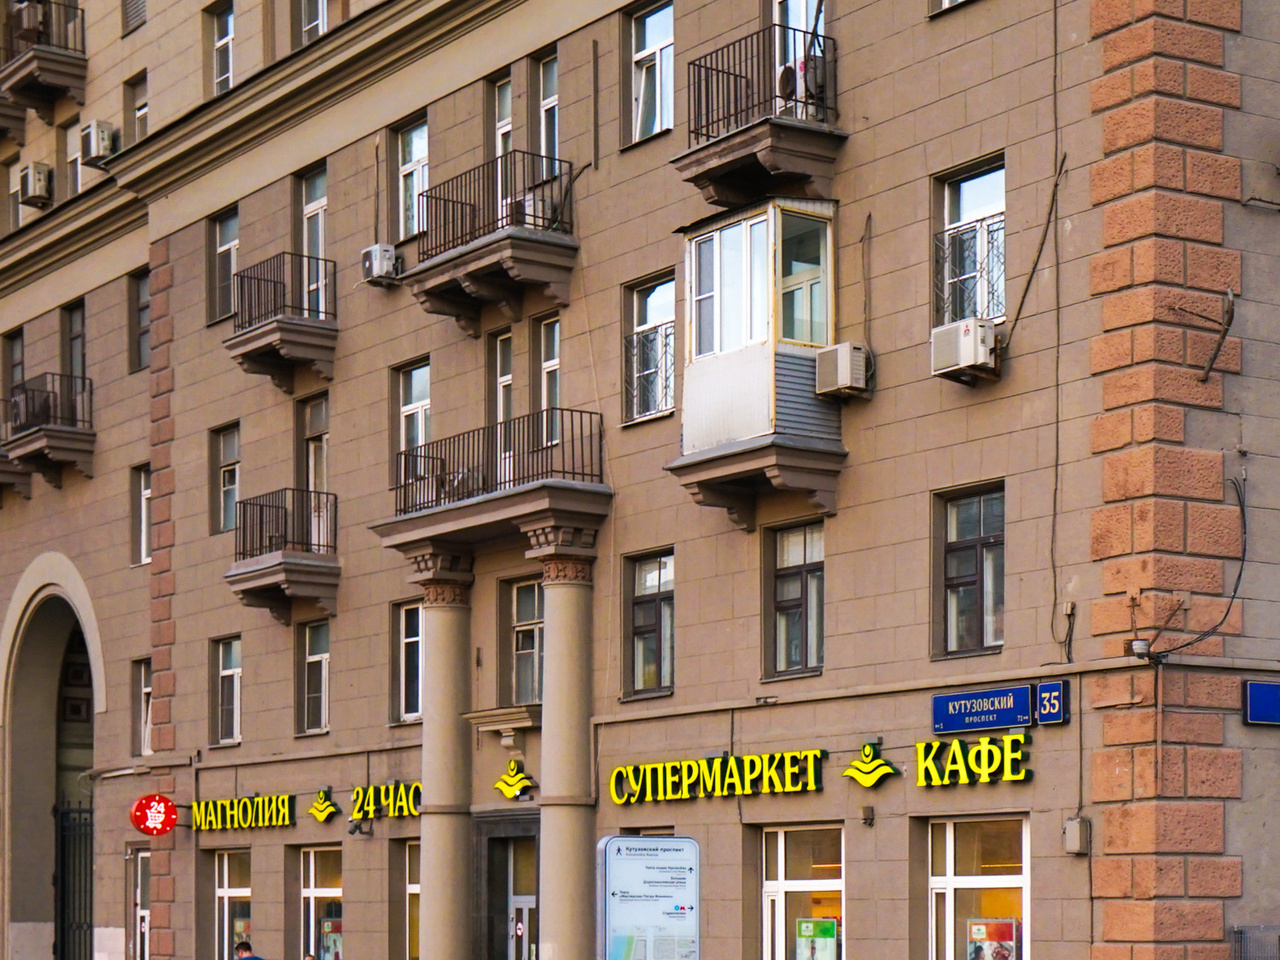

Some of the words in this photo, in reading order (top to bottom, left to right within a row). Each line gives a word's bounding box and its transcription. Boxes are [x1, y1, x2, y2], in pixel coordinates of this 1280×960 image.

[948, 692, 1014, 715] КУТУЗОВСКИЙ
[1040, 691, 1060, 714] 35
[965, 714, 997, 724] ПРОСПЕКТ
[915, 733, 1026, 787] КАФЕ
[609, 749, 821, 805] СУПЕРМАРКЕТ
[150, 801, 165, 813] 24
[192, 794, 290, 831] МАГНОЛИЯ
[352, 784, 376, 820] 24
[380, 781, 422, 818] ЧАС
